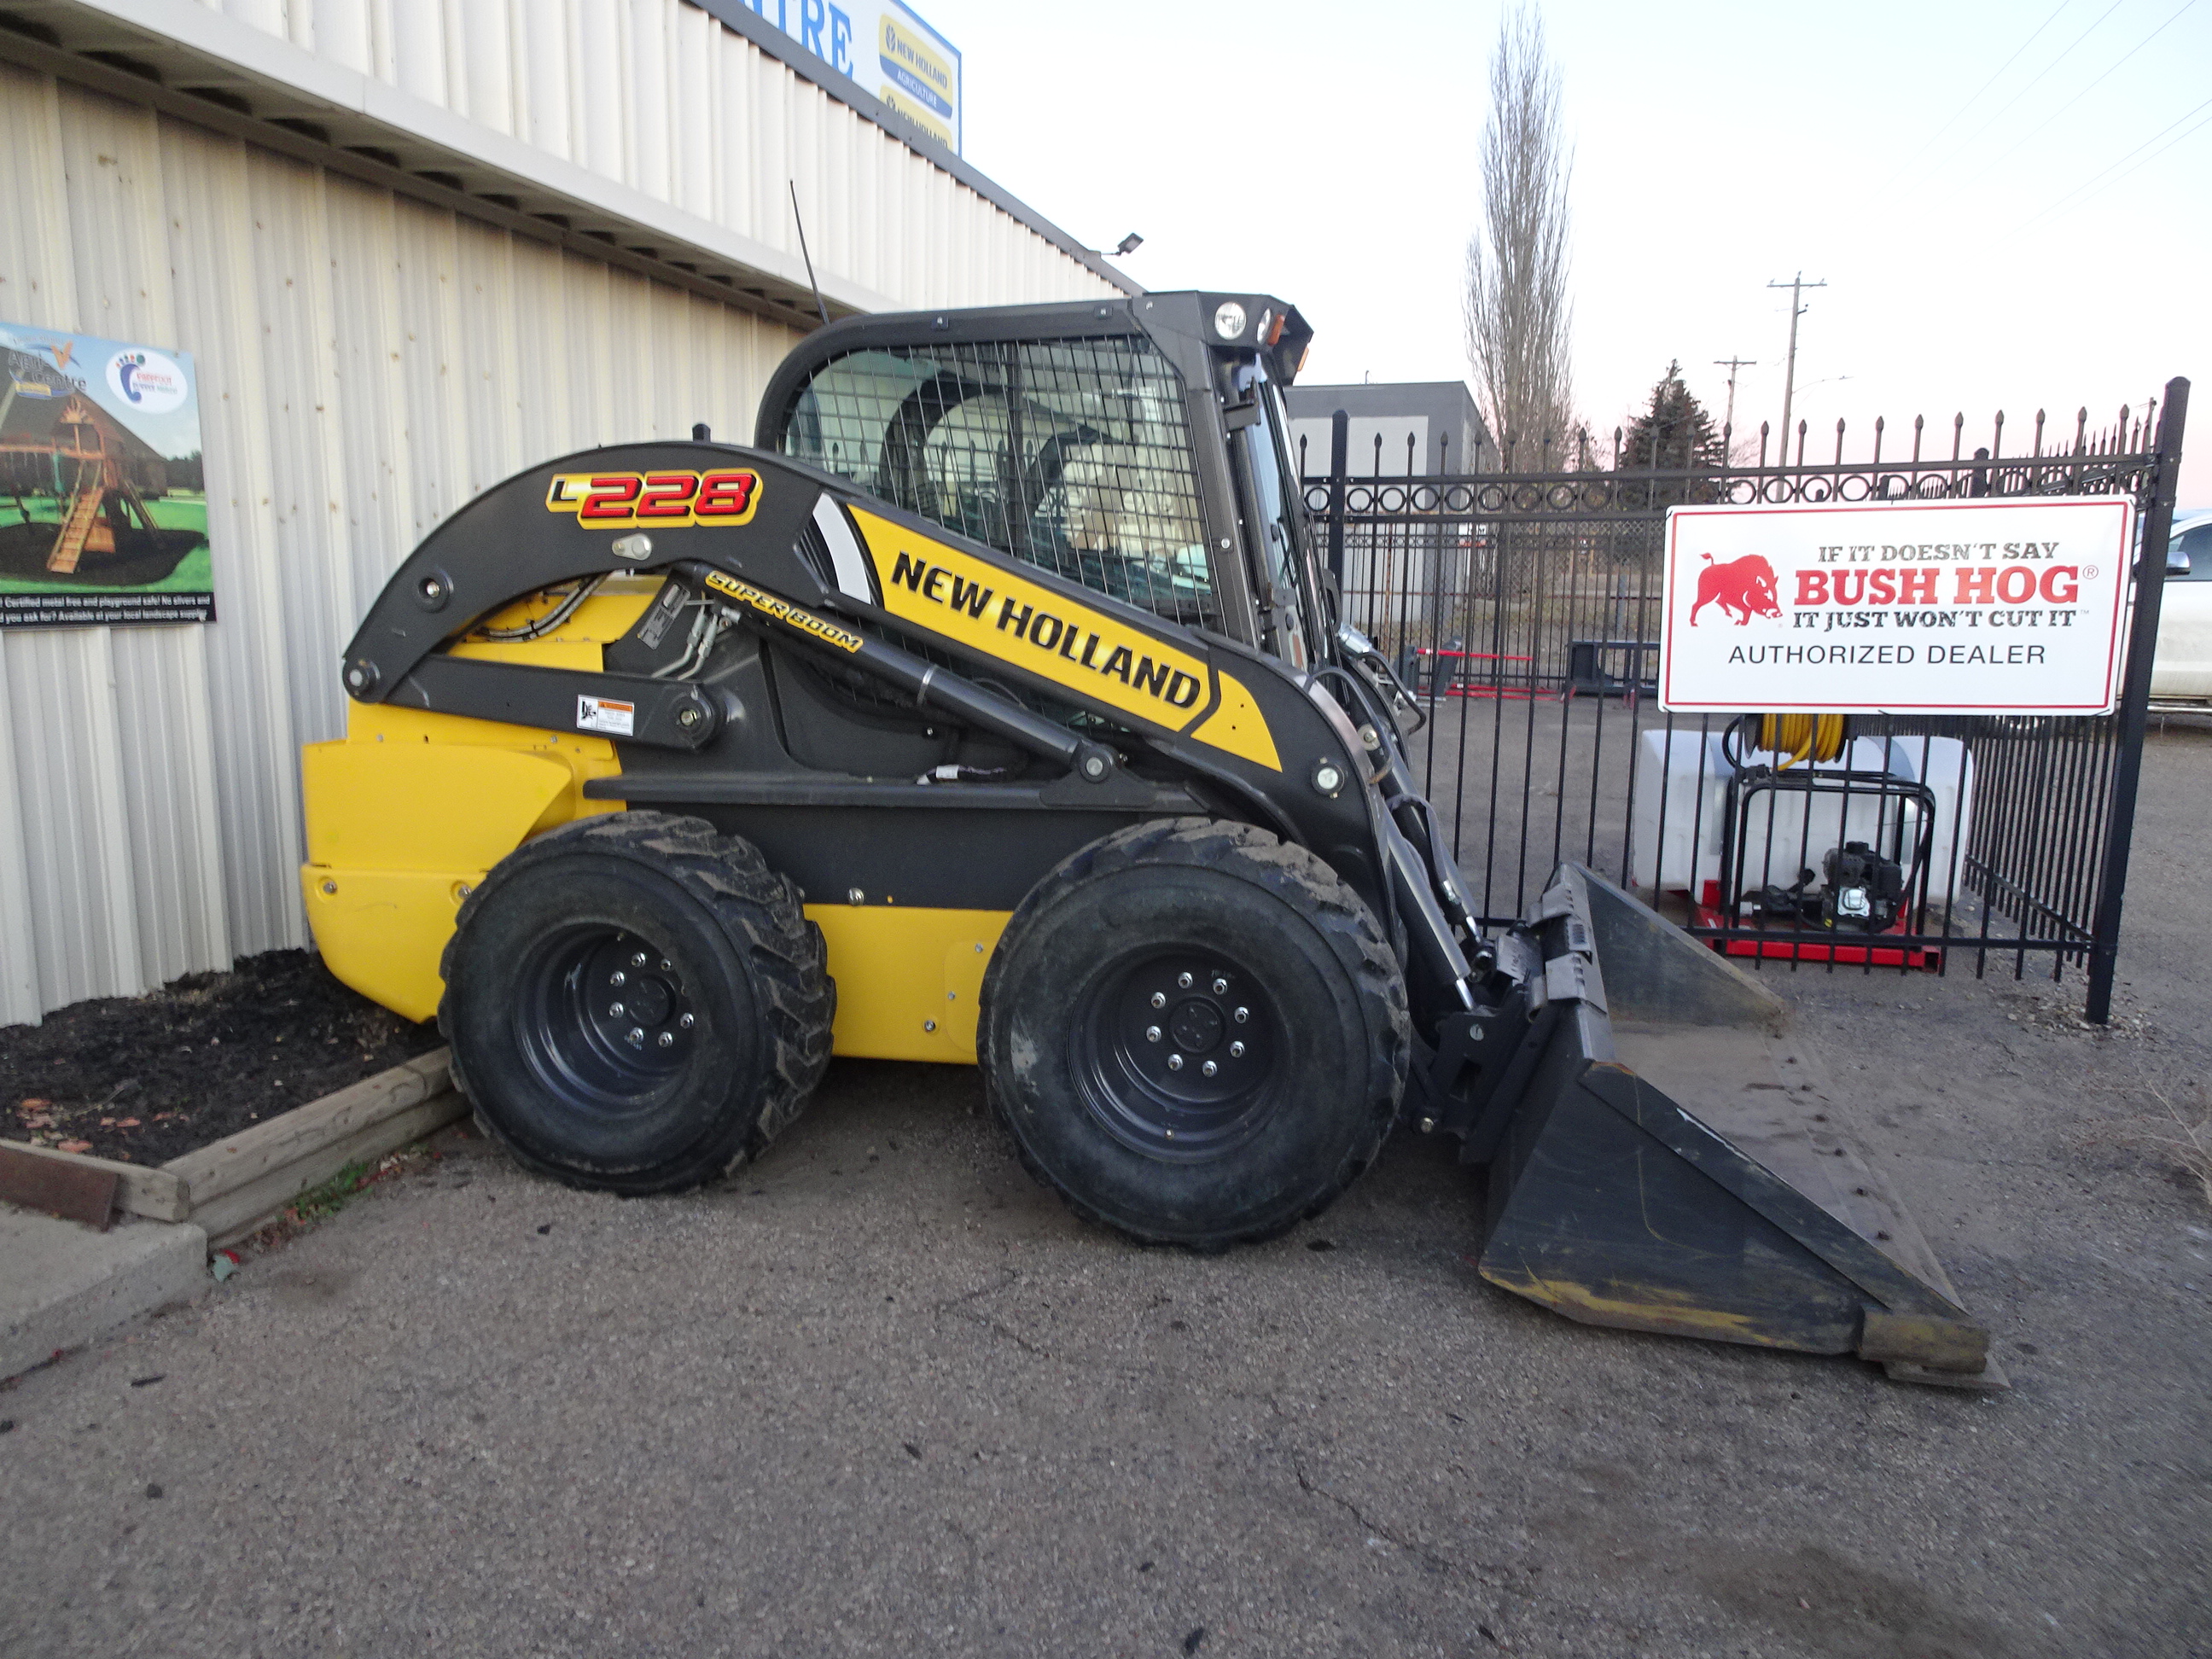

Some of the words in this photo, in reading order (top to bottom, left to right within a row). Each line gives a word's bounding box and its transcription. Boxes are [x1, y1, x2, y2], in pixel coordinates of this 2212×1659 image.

[896, 36, 915, 61] NEW
[915, 52, 948, 90] HOLLAND
[896, 68, 938, 108] AGRICULTURE
[547, 472, 761, 526] L228
[1819, 545, 1842, 562] IF
[1848, 544, 1875, 562] IT
[1880, 542, 1998, 562] DOESN'T
[2002, 541, 2060, 560] SAY
[1793, 568, 1940, 606] BUSH
[1953, 565, 2080, 605] HOG
[5, 596, 41, 608] Certified
[42, 596, 65, 608] metal
[66, 596, 82, 607] free
[83, 596, 98, 607] and
[99, 596, 141, 608] playground
[162, 595, 172, 606] No
[173, 595, 197, 606] slivers
[197, 596, 211, 606] and
[5, 613, 22, 624] you
[23, 611, 38, 622] ask
[58, 610, 95, 621] Available
[96, 610, 104, 620] at
[104, 611, 122, 621] your
[123, 609, 141, 620] local
[142, 609, 178, 620] landscape
[890, 550, 994, 620] NEW
[995, 595, 1202, 710] HOLLAND
[1792, 612, 1819, 628] IT
[1823, 611, 1889, 632] JUST
[1893, 609, 1982, 629] WON'T
[1988, 609, 2043, 628] CUT
[2047, 609, 2077, 627] IT
[1727, 644, 1916, 665] AUTHORIZED
[1926, 644, 2046, 665] DEALER
